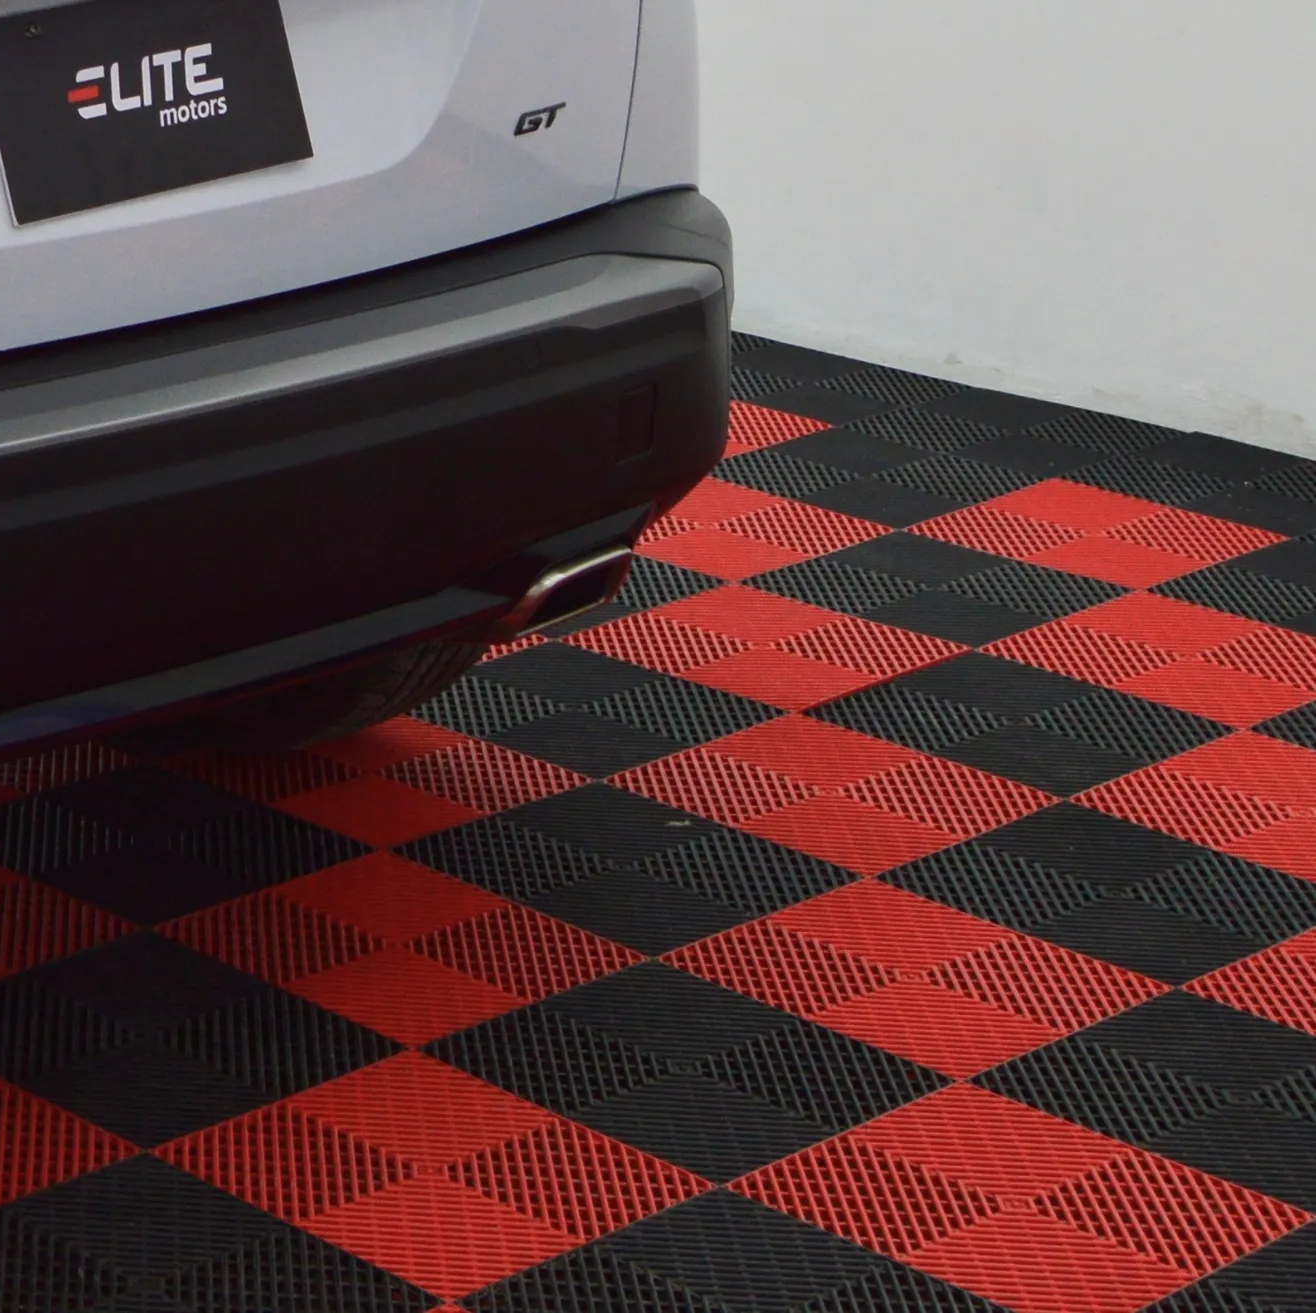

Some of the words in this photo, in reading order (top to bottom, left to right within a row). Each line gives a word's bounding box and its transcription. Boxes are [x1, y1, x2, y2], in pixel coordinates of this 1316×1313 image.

[67, 42, 225, 120] ELITE
[159, 96, 228, 128] motors
[513, 101, 567, 136] GT
